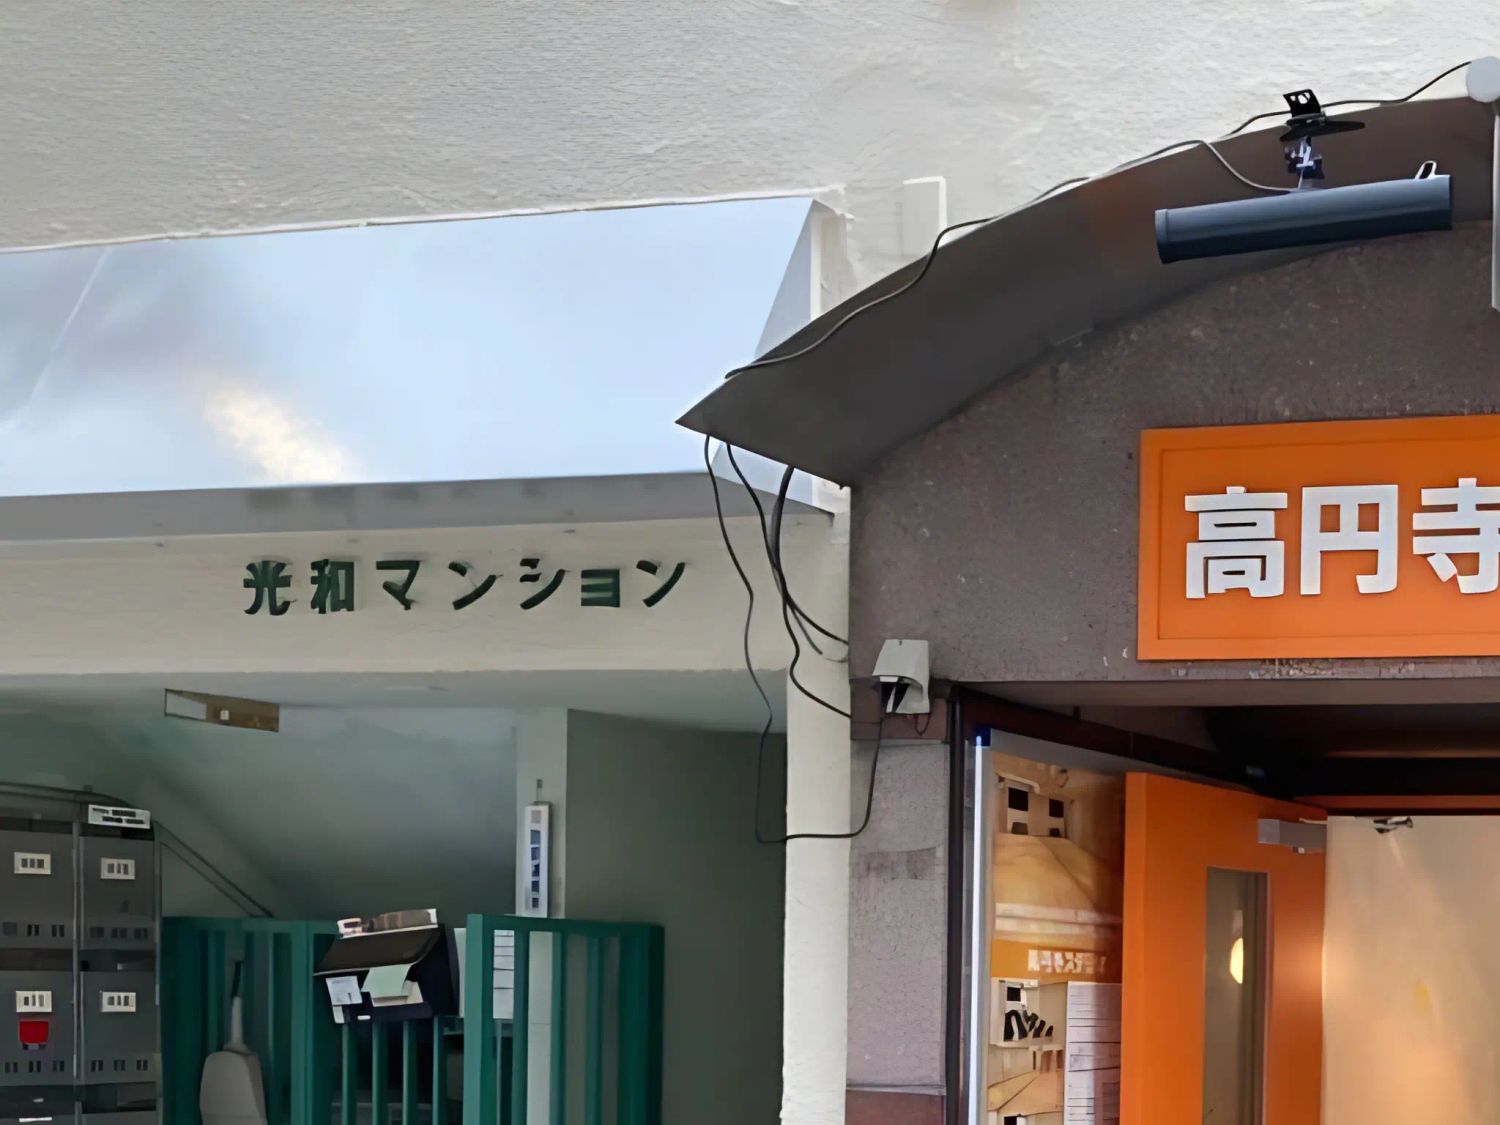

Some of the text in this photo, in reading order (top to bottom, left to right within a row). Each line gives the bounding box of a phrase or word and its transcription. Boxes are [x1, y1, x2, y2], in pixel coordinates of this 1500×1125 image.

[243, 559, 686, 616] 光和マンション
